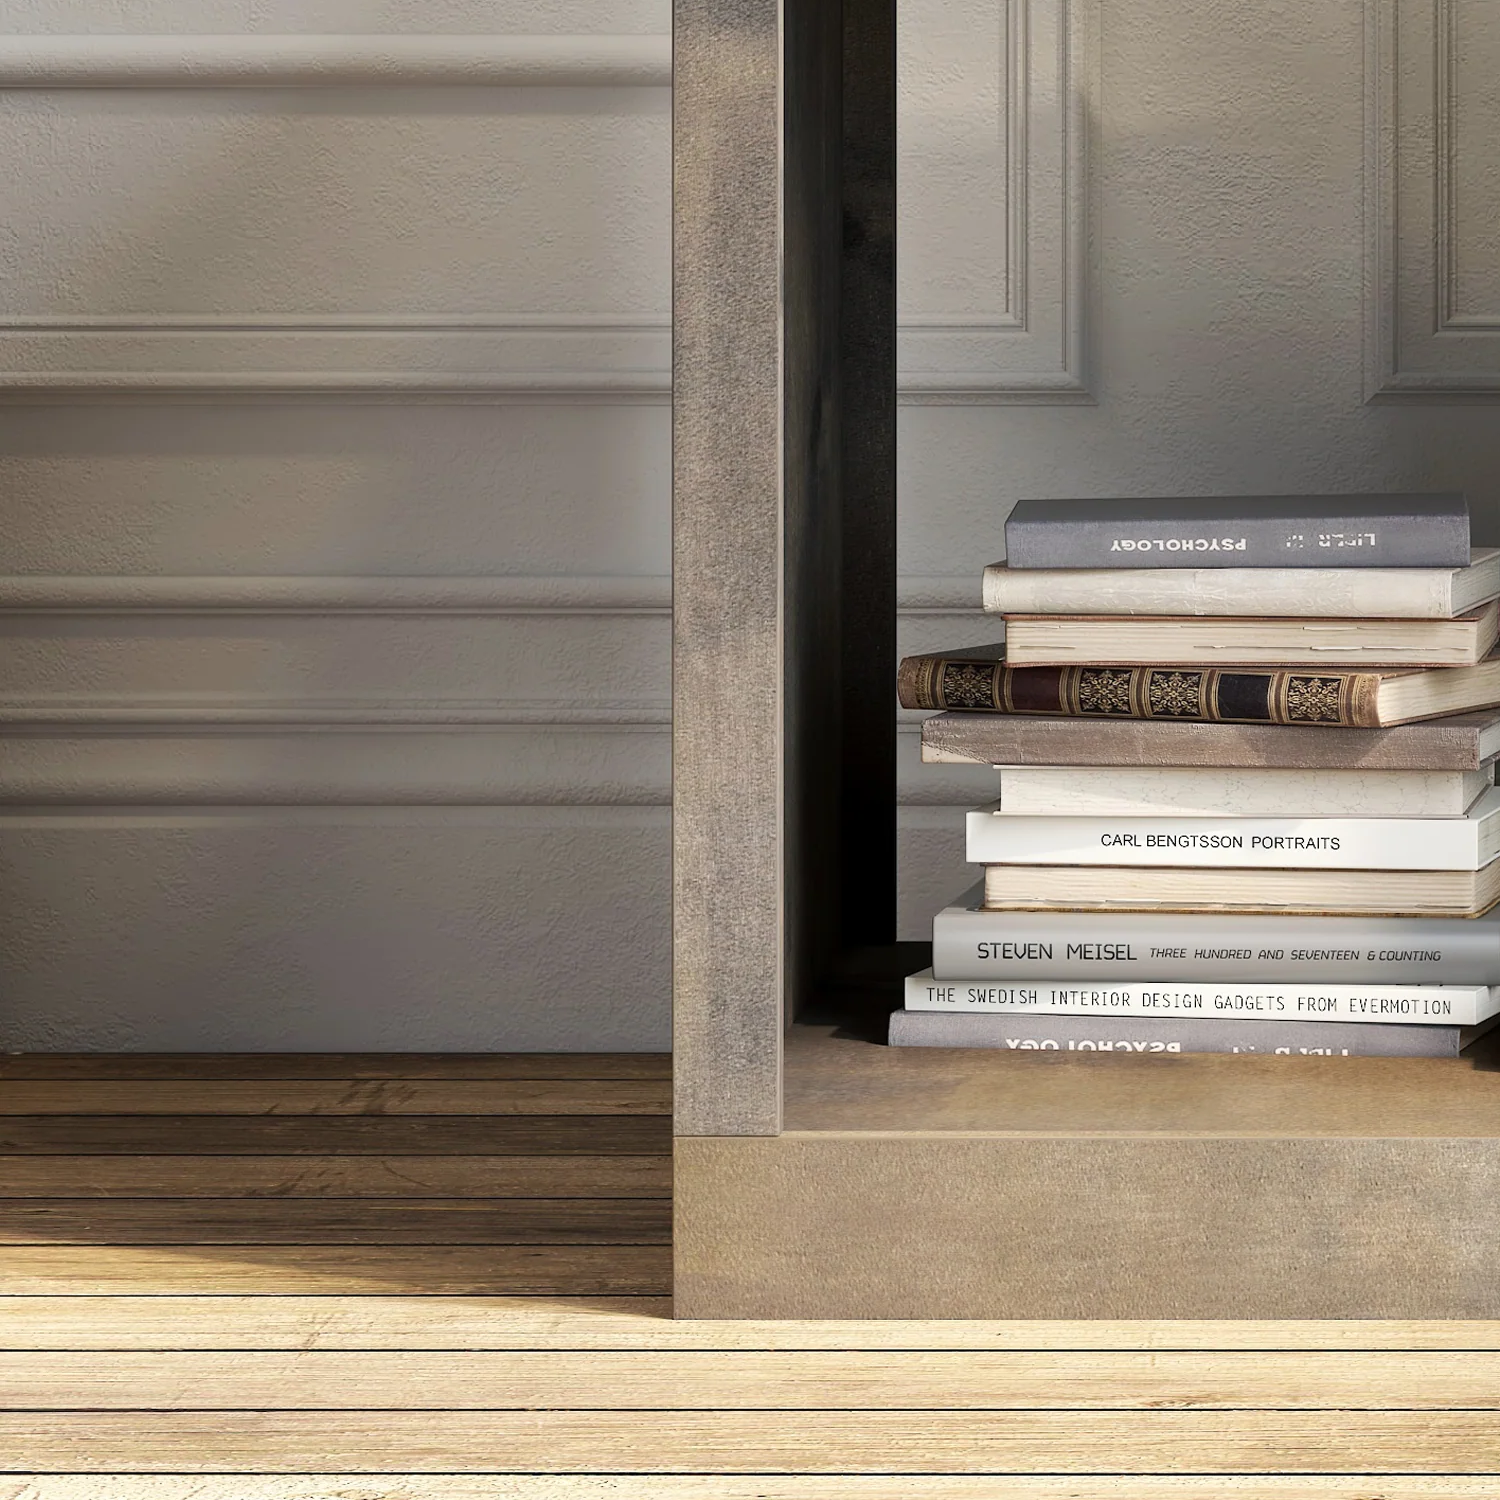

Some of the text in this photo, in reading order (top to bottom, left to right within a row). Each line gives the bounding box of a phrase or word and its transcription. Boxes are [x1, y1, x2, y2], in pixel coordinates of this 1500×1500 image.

[1110, 538, 1247, 551] PSYCHOLOGY
[1100, 834, 1341, 850] CARL BENGTSSON PORTRAITS
[977, 942, 1442, 961] STEVEN MEISEL THREE HUNDRED AND SEVENTEEN & COUNTING
[926, 986, 1452, 1015] THE SWEDISH INTERIOR DESIGN GADGETS FROM EVERMOTION
